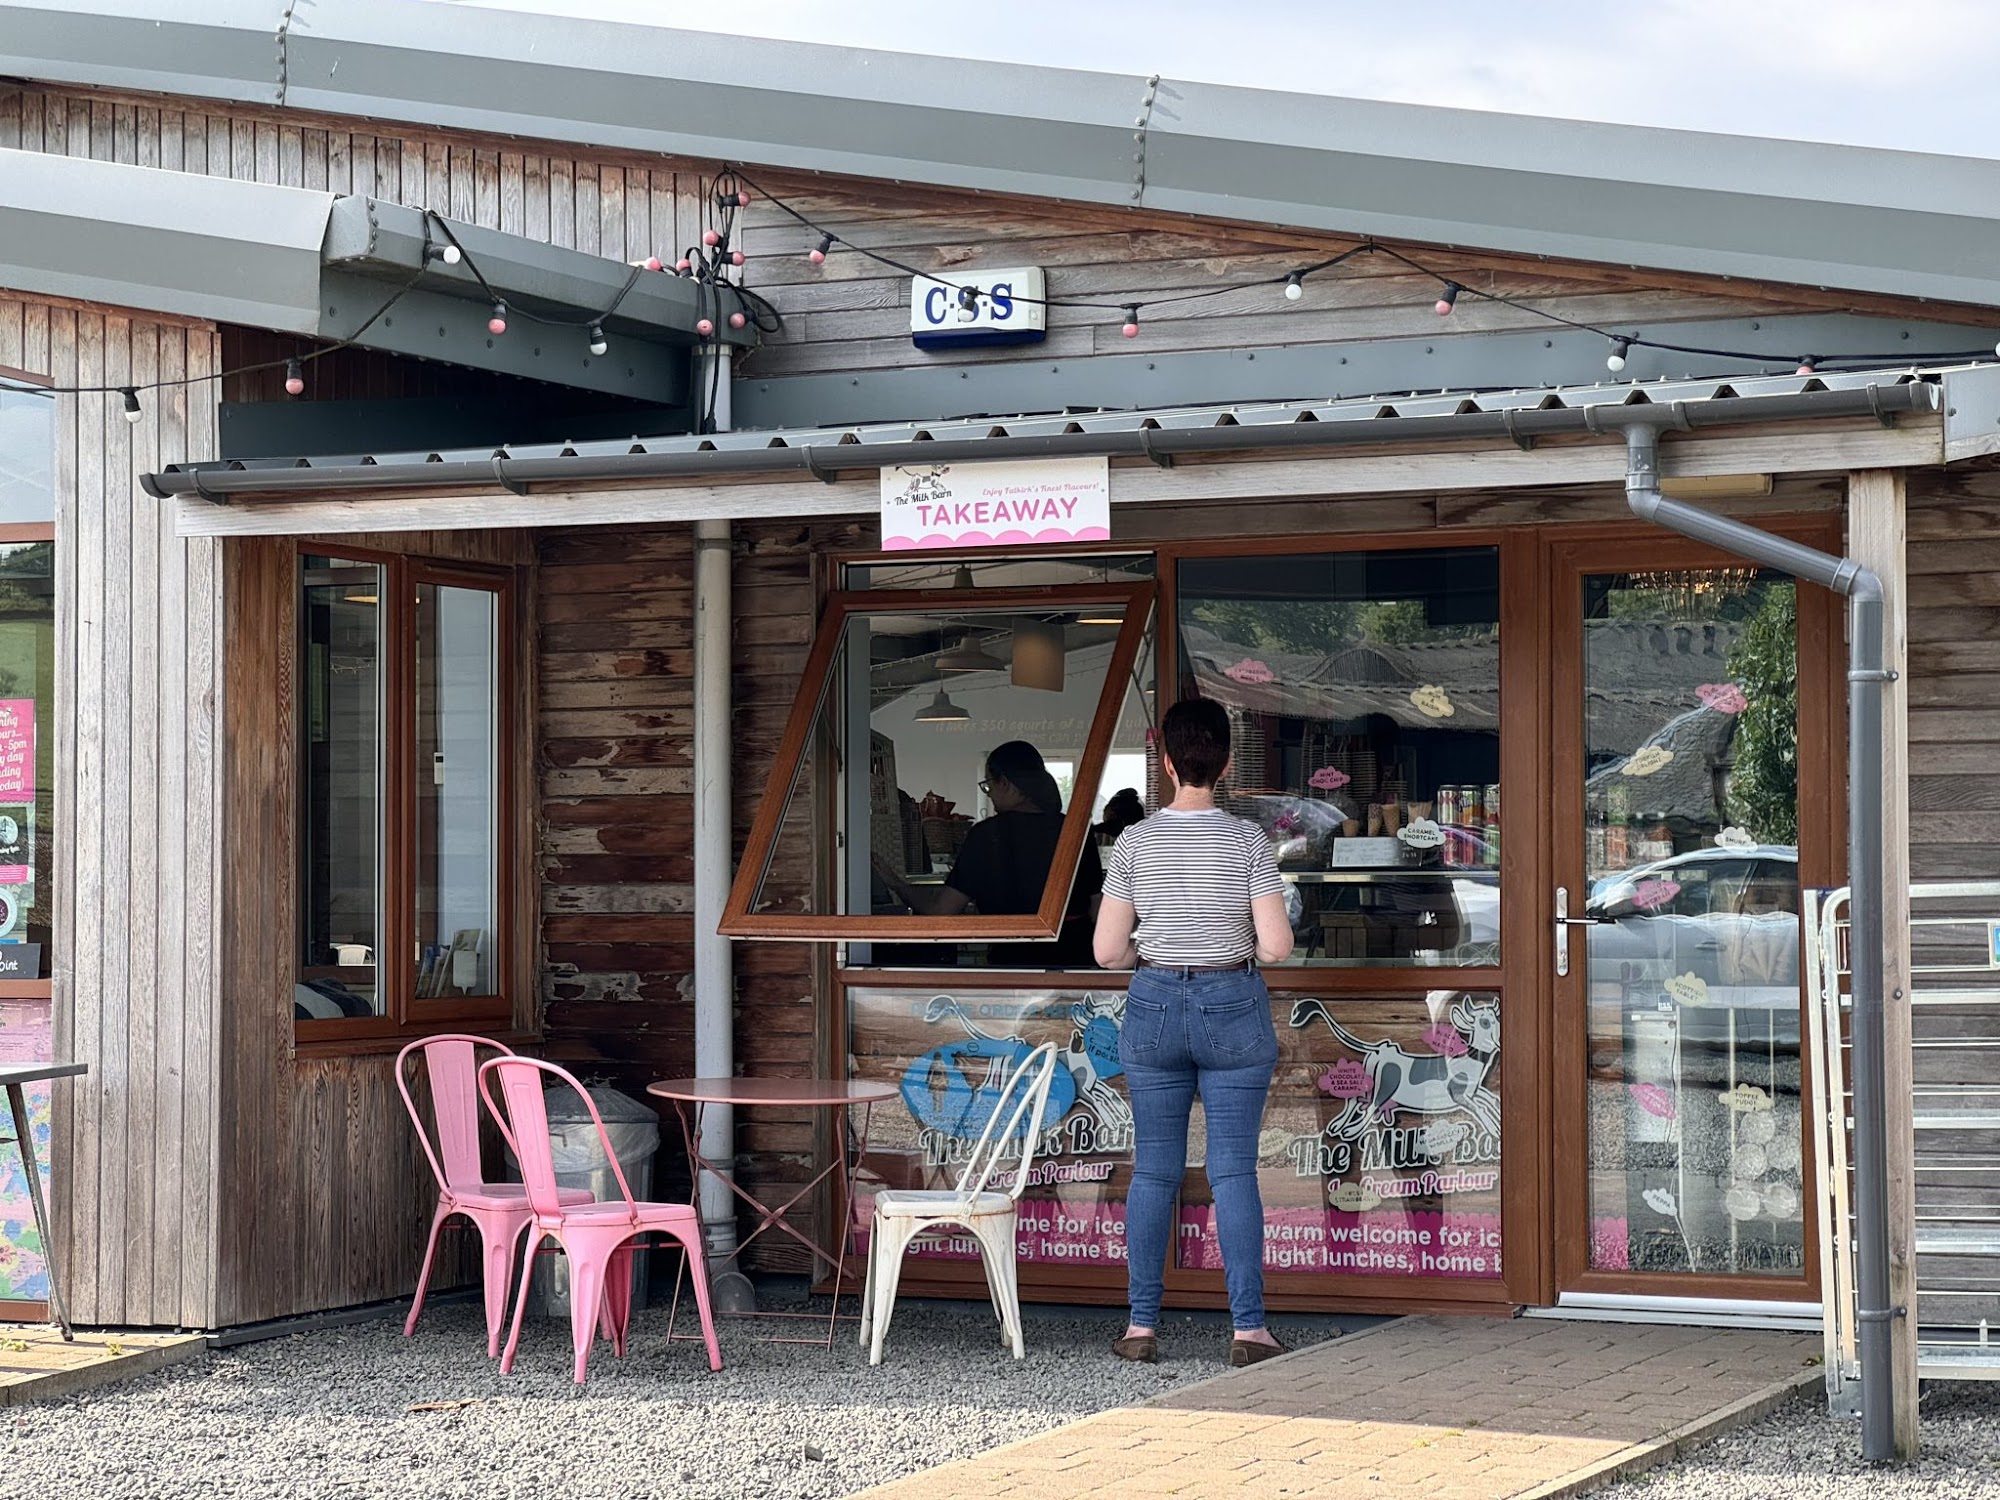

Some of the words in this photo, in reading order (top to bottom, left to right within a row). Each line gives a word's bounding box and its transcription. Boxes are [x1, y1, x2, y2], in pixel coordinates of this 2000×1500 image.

[894, 496, 909, 506] The
[911, 493, 930, 503] Milk
[931, 490, 953, 500] Barn
[982, 488, 1003, 496] Enjoy
[1005, 485, 1039, 494] Falkirk's
[1041, 484, 1062, 492] Finest
[1064, 482, 1100, 491] Flavours!
[916, 496, 1078, 527] TAKEAWAY
[7, 751, 24, 764] day
[1404, 833, 1439, 842] SHORTCAKE
[1407, 827, 1436, 836] CARAMEL
[1735, 1092, 1759, 1100] TOFFEE
[1066, 1112, 1135, 1154] Bar
[1287, 1130, 1351, 1177] The
[985, 1166, 1041, 1189] Crem
[1041, 1160, 1114, 1186] Parlour
[1360, 1175, 1421, 1199] Cream
[1421, 1169, 1500, 1196] Parlour
[1057, 1214, 1088, 1234] for
[1095, 1215, 1126, 1235] ice
[1263, 1224, 1323, 1242] warm
[1330, 1223, 1431, 1244] welcome
[1439, 1225, 1473, 1246] for
[1480, 1227, 1501, 1248] ic
[1041, 1237, 1101, 1258] home
[1265, 1244, 1317, 1269] light
[1322, 1244, 1414, 1273] lunches,
[1422, 1251, 1487, 1273] home
